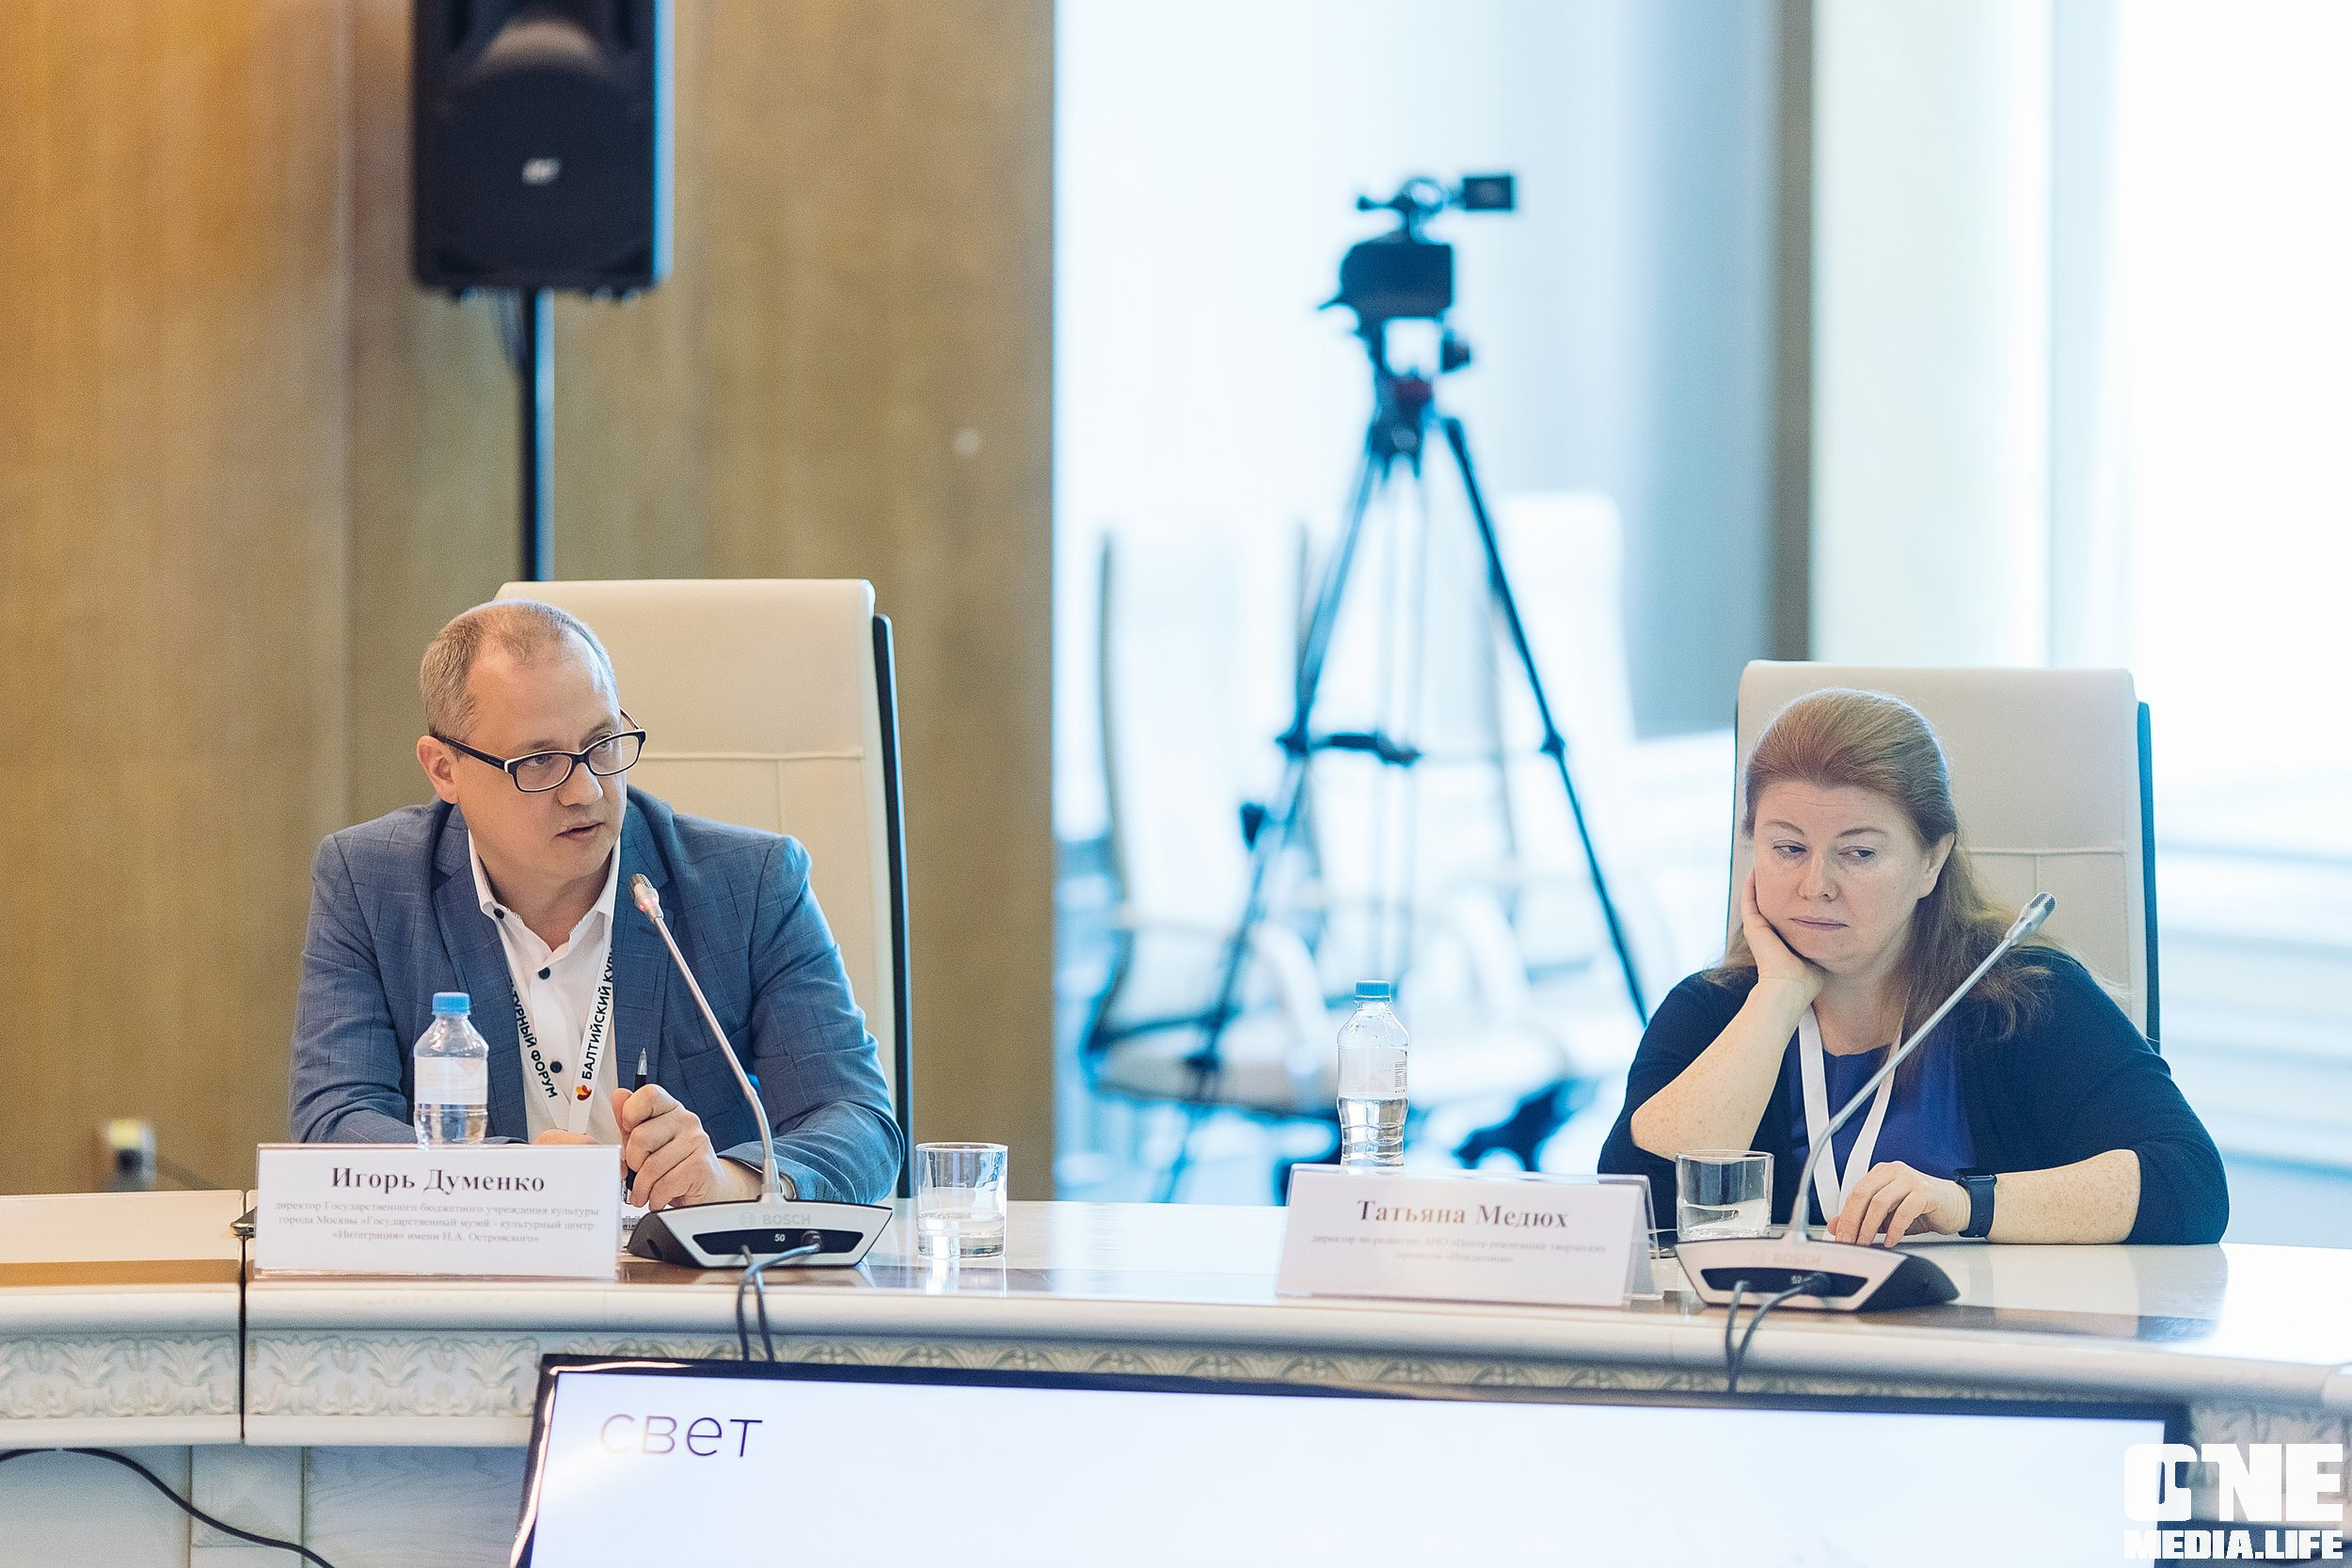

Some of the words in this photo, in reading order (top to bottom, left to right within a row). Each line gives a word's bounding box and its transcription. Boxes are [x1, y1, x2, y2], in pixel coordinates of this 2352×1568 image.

[581, 986, 612, 1080] БАЛТИЙСКИЙ
[531, 1050, 558, 1098] ФОРУМ
[331, 1167, 415, 1194] Игорь
[423, 1168, 546, 1195] Думенко
[274, 1202, 322, 1212] директор
[325, 1201, 418, 1213] Государственного
[420, 1203, 483, 1214] бюджетного
[485, 1206, 548, 1216] учреждения
[550, 1207, 599, 1217] культуры
[762, 1213, 811, 1226] BOSCH
[1357, 1199, 1467, 1225] Татьяна
[1476, 1204, 1569, 1229] Медюх
[278, 1217, 313, 1227] города
[315, 1216, 358, 1226] Москвы
[459, 1218, 490, 1227] музей
[500, 1220, 562, 1230] культурный
[564, 1223, 595, 1231] центр
[774, 1233, 786, 1243] 50
[1773, 1252, 1821, 1267] BOSCH
[600, 1413, 763, 1458] свет
